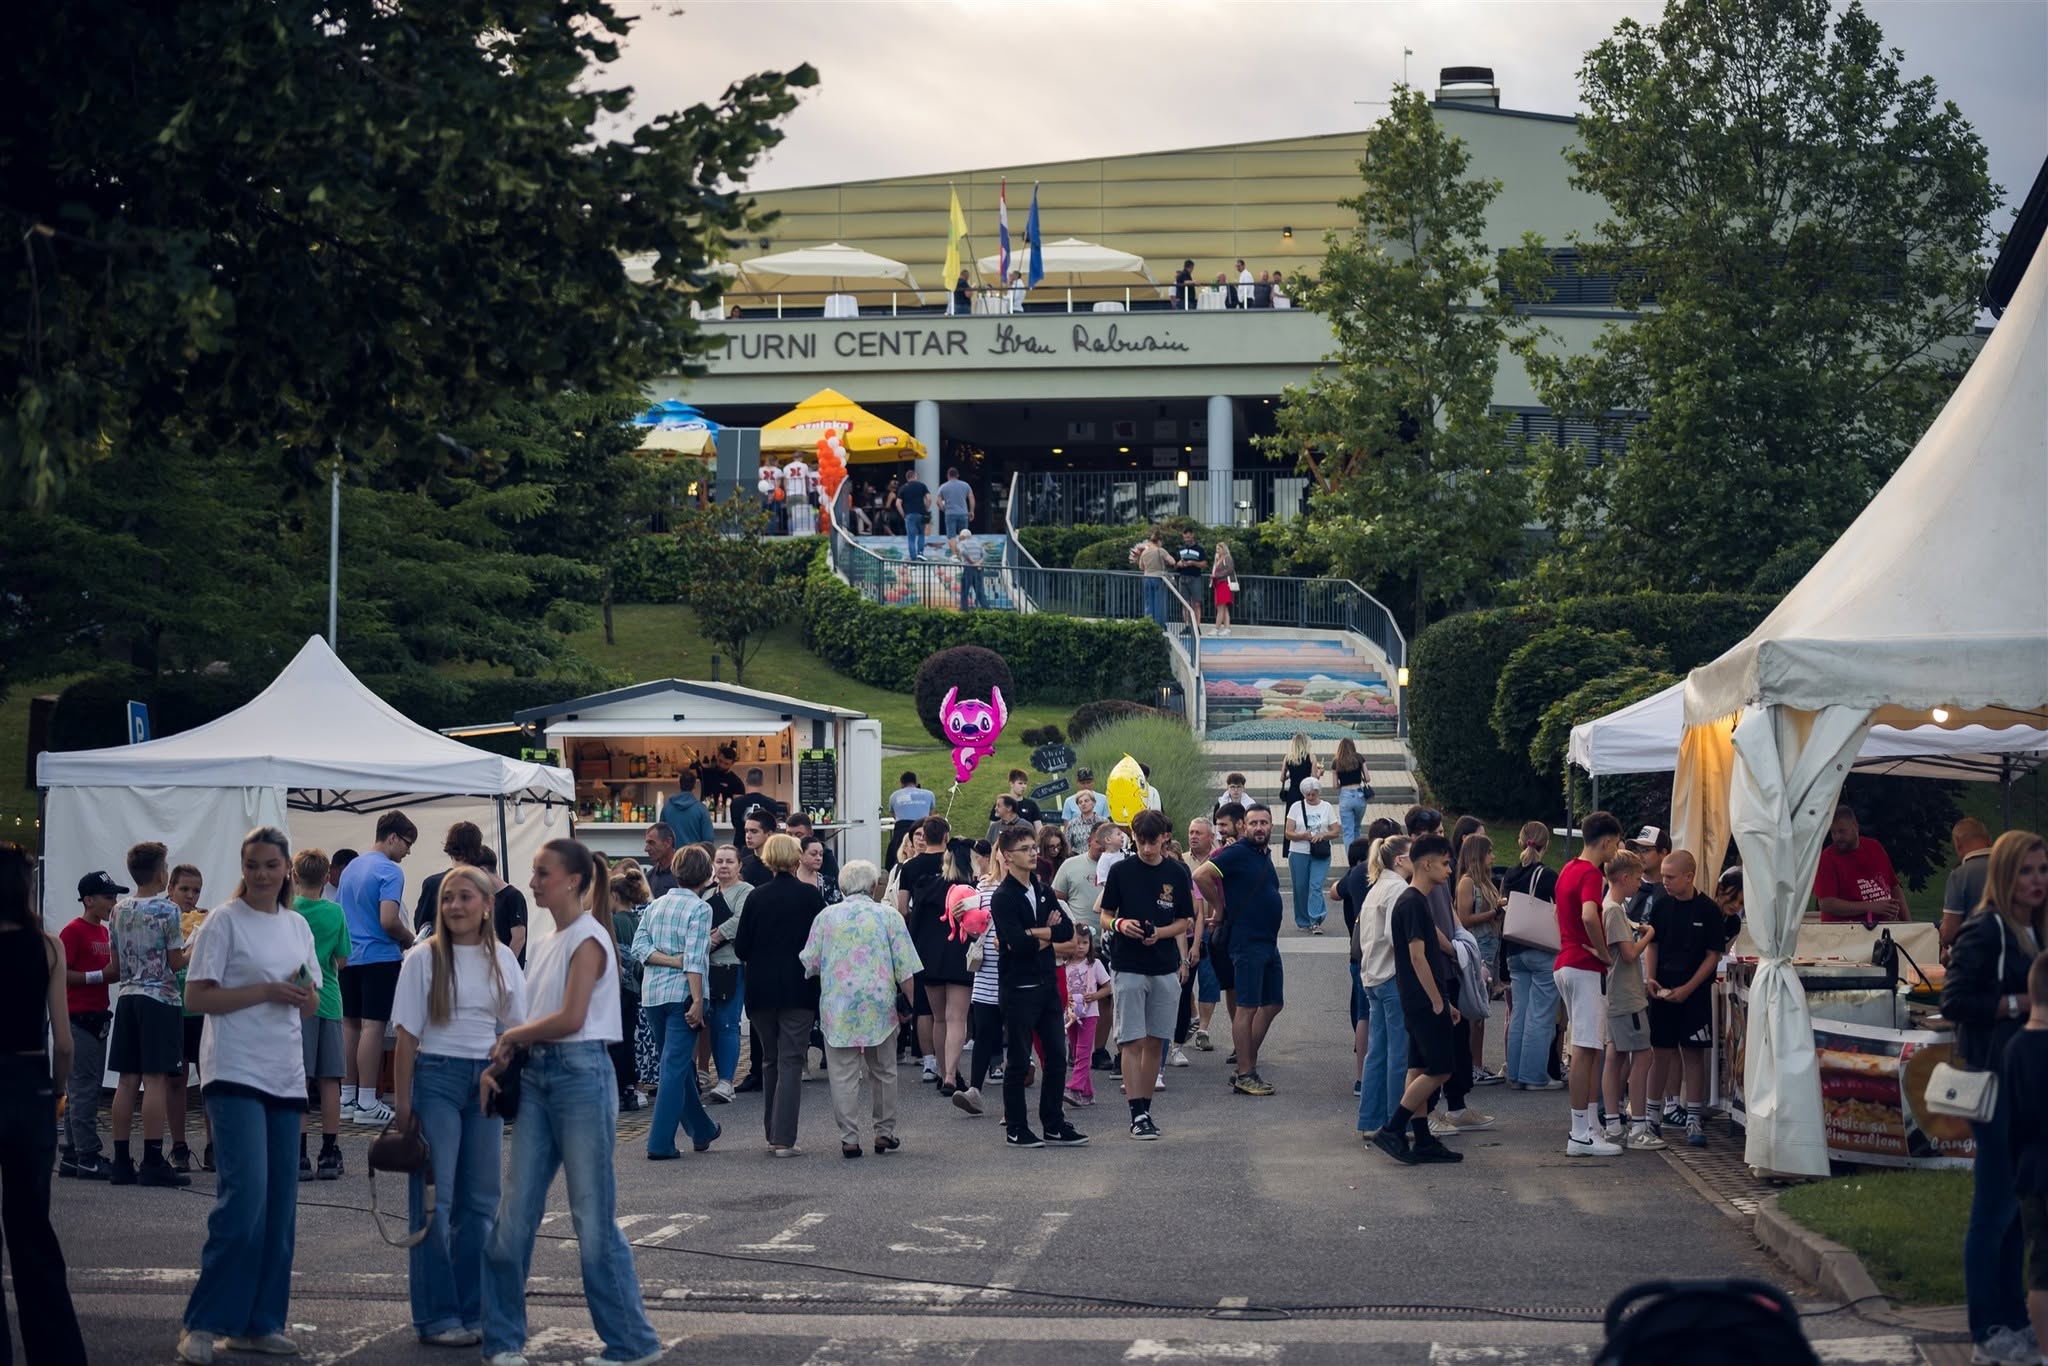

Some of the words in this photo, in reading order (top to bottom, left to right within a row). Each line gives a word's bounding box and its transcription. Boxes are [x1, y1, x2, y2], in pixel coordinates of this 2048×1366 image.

[684, 333, 815, 360] LTURNI
[834, 330, 968, 357] CENTAR
[135, 716, 145, 744] P
[1825, 1111, 1867, 1130] basice
[1826, 1127, 1850, 1143] lim
